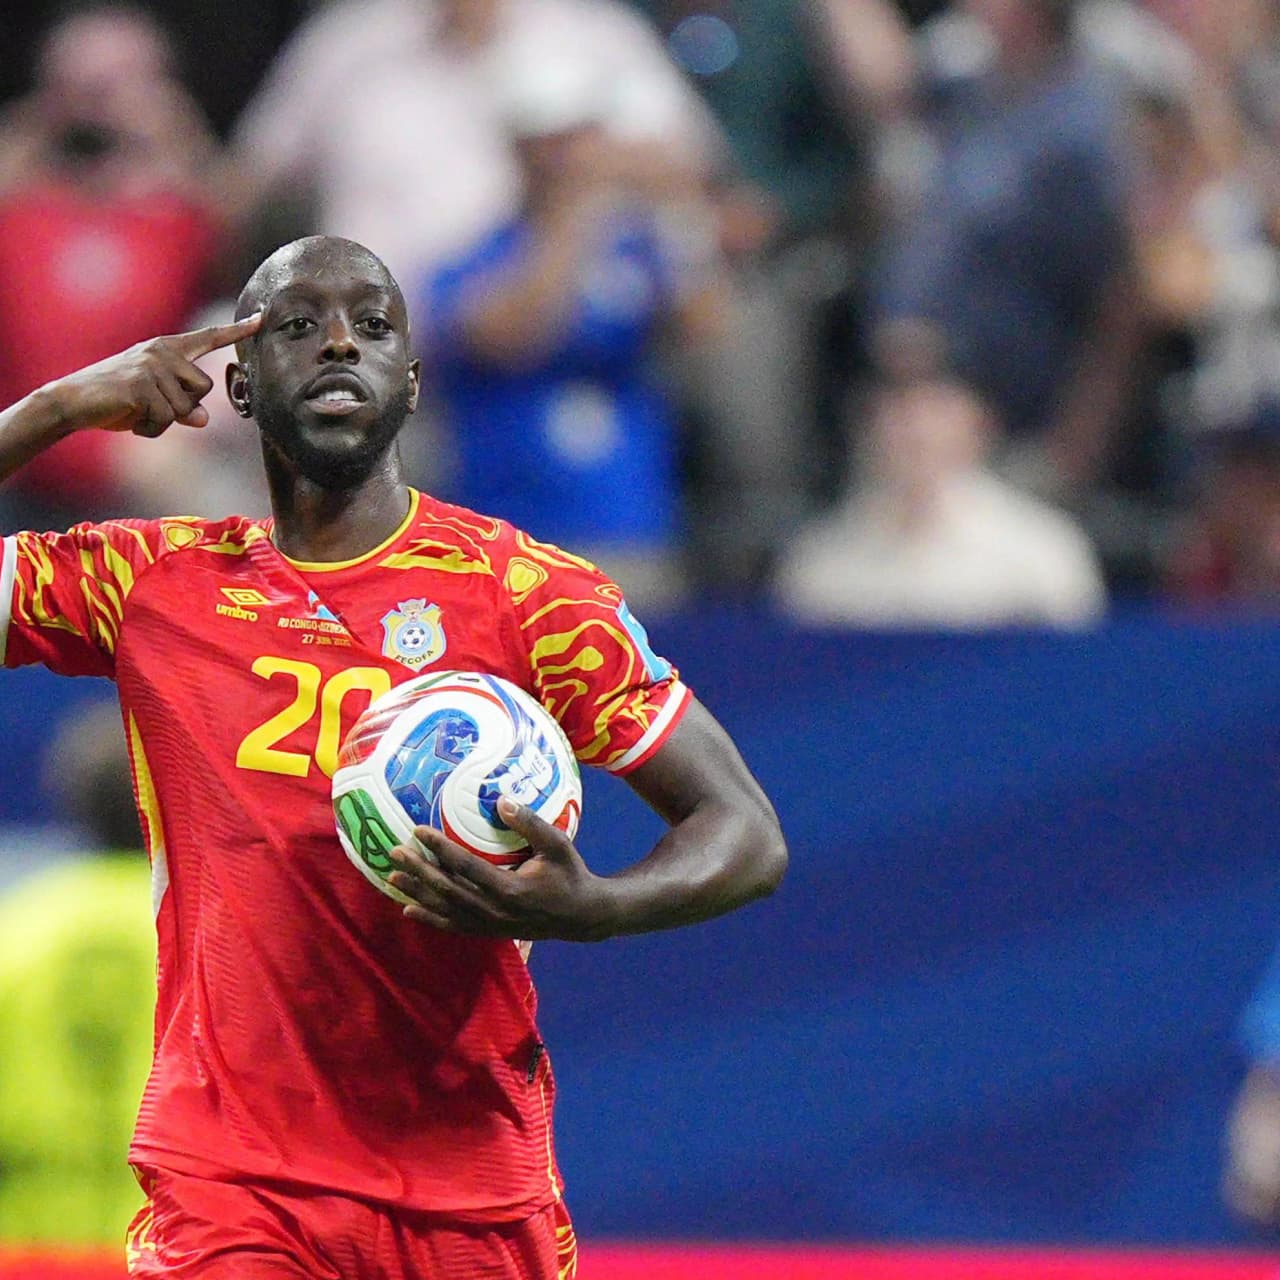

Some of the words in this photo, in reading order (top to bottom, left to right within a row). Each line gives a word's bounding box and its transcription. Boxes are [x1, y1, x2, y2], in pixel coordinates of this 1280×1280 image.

[216, 603, 258, 622] umbro
[395, 649, 434, 665] FECOFA
[236, 655, 392, 778] 20
